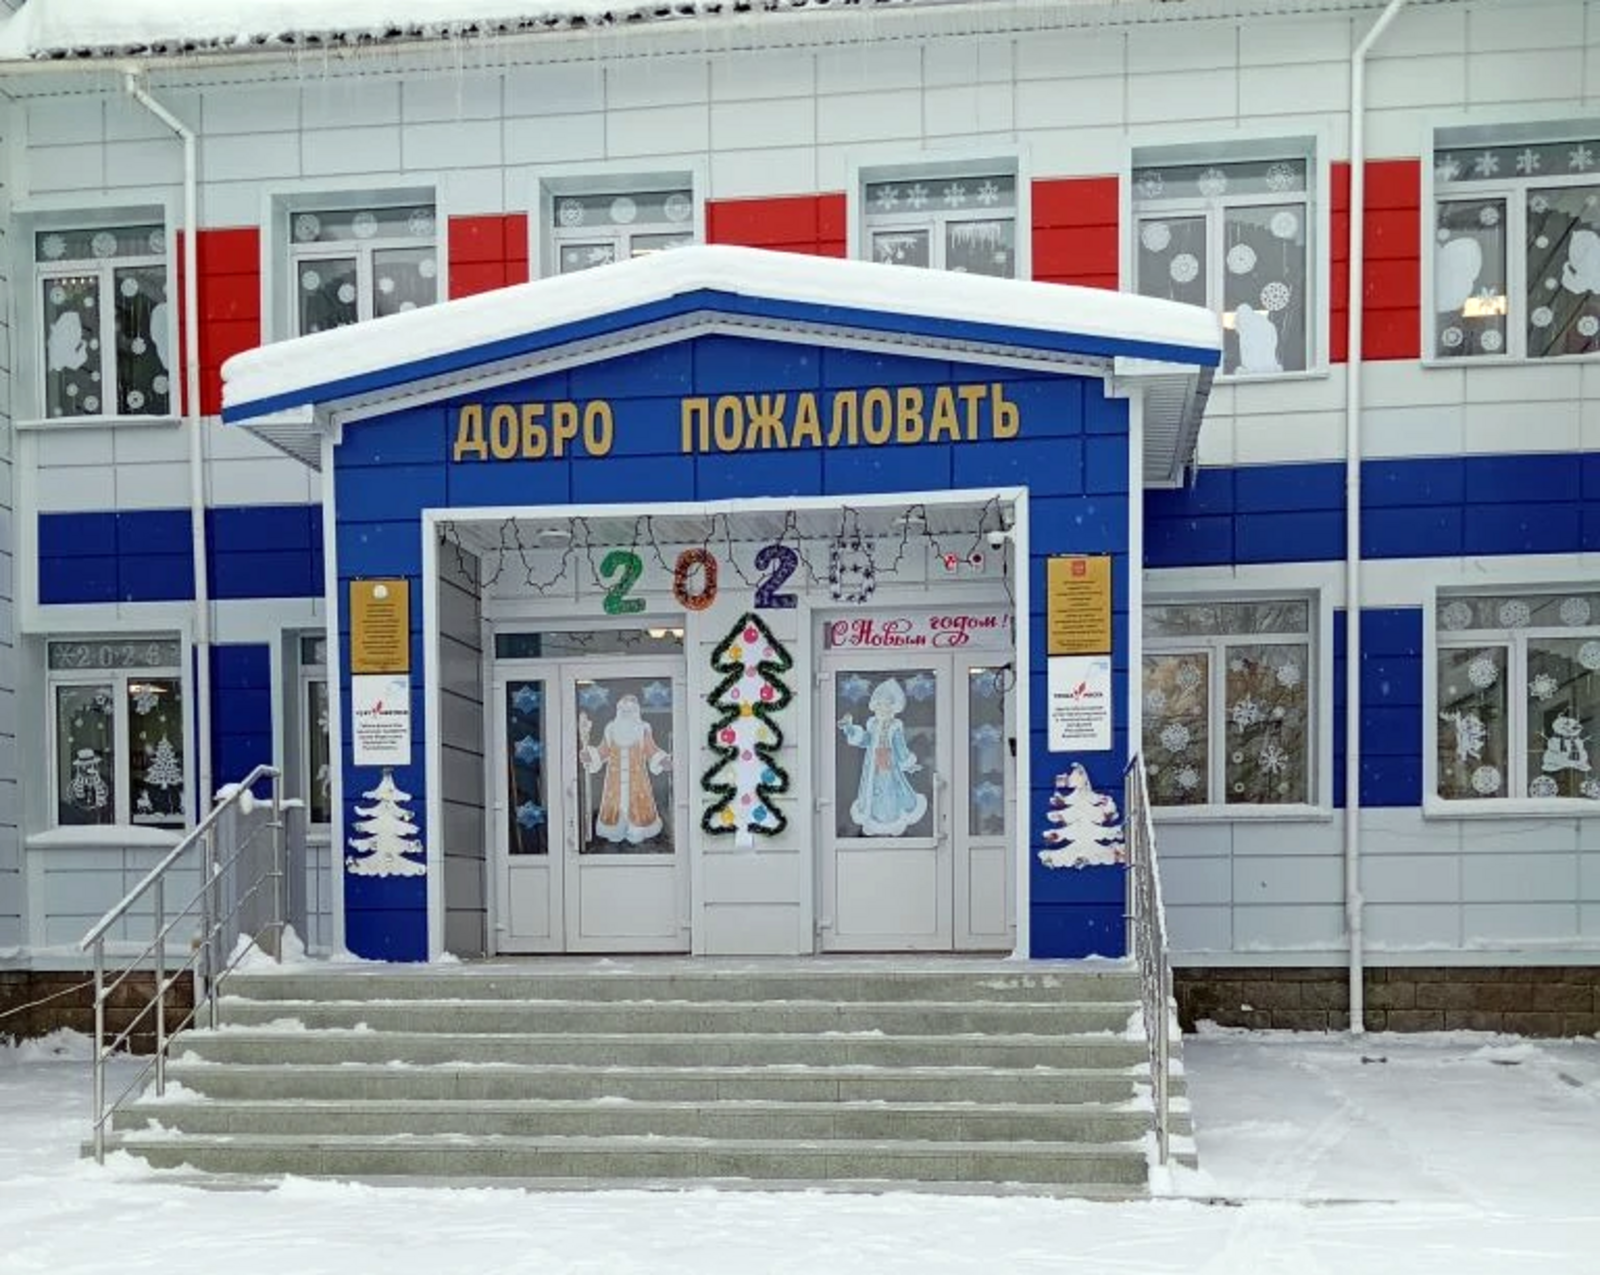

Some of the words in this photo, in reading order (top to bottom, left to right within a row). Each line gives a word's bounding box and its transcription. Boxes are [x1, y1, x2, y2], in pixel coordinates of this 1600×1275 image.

[453, 399, 614, 462] ДОБРО
[681, 382, 1020, 453] ПОЖАЛОВАТЬ
[831, 620, 849, 647] С
[849, 618, 927, 647] Новым
[929, 613, 1009, 649] годом!
